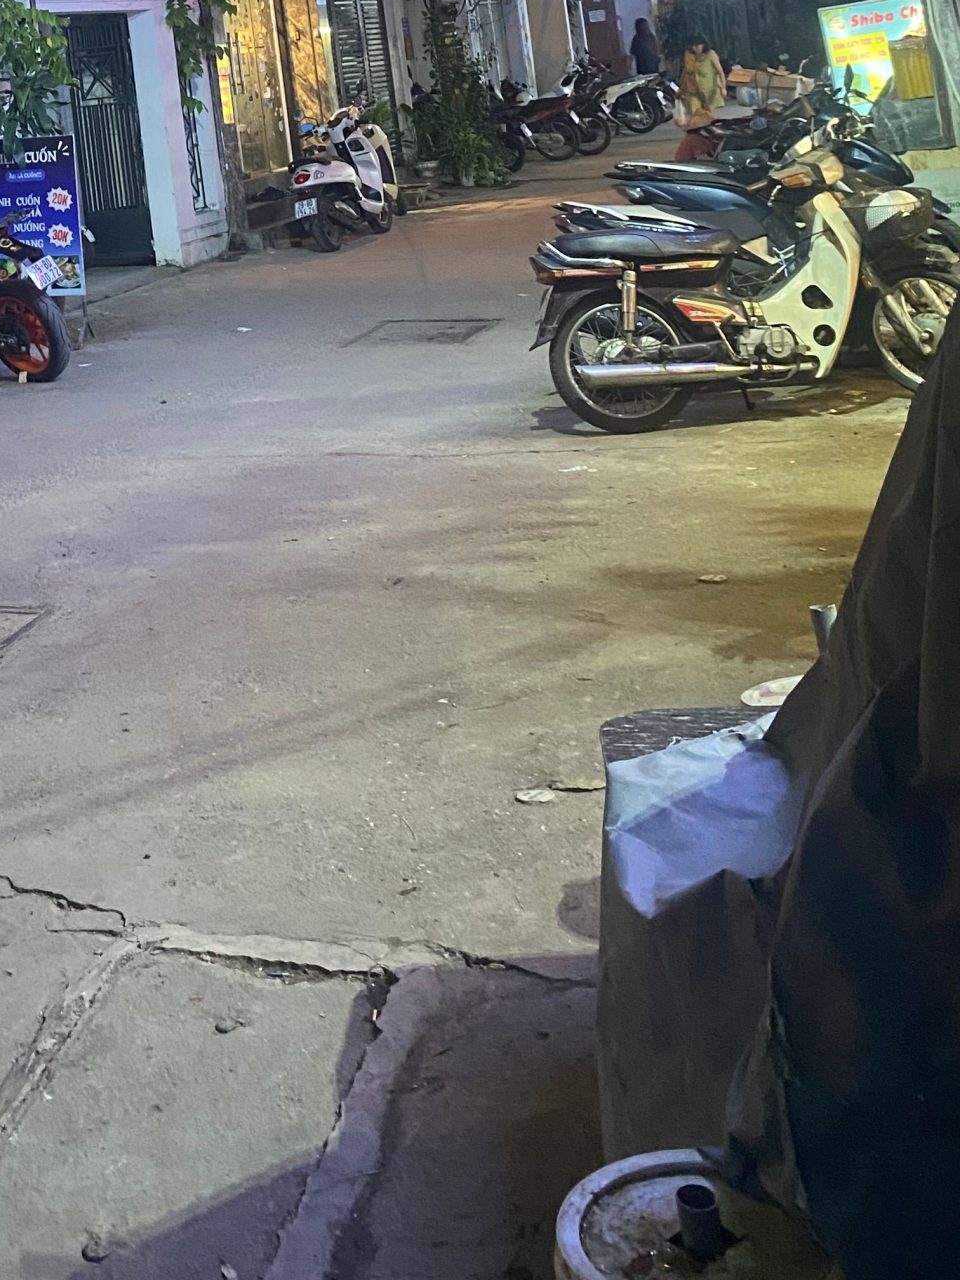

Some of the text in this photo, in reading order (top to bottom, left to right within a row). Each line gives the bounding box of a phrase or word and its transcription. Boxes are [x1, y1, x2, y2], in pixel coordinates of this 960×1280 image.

[24, 145, 57, 163] CUỐN
[16, 193, 40, 206] CUỐN
[52, 192, 69, 206] 20K
[52, 229, 69, 243] 30K
